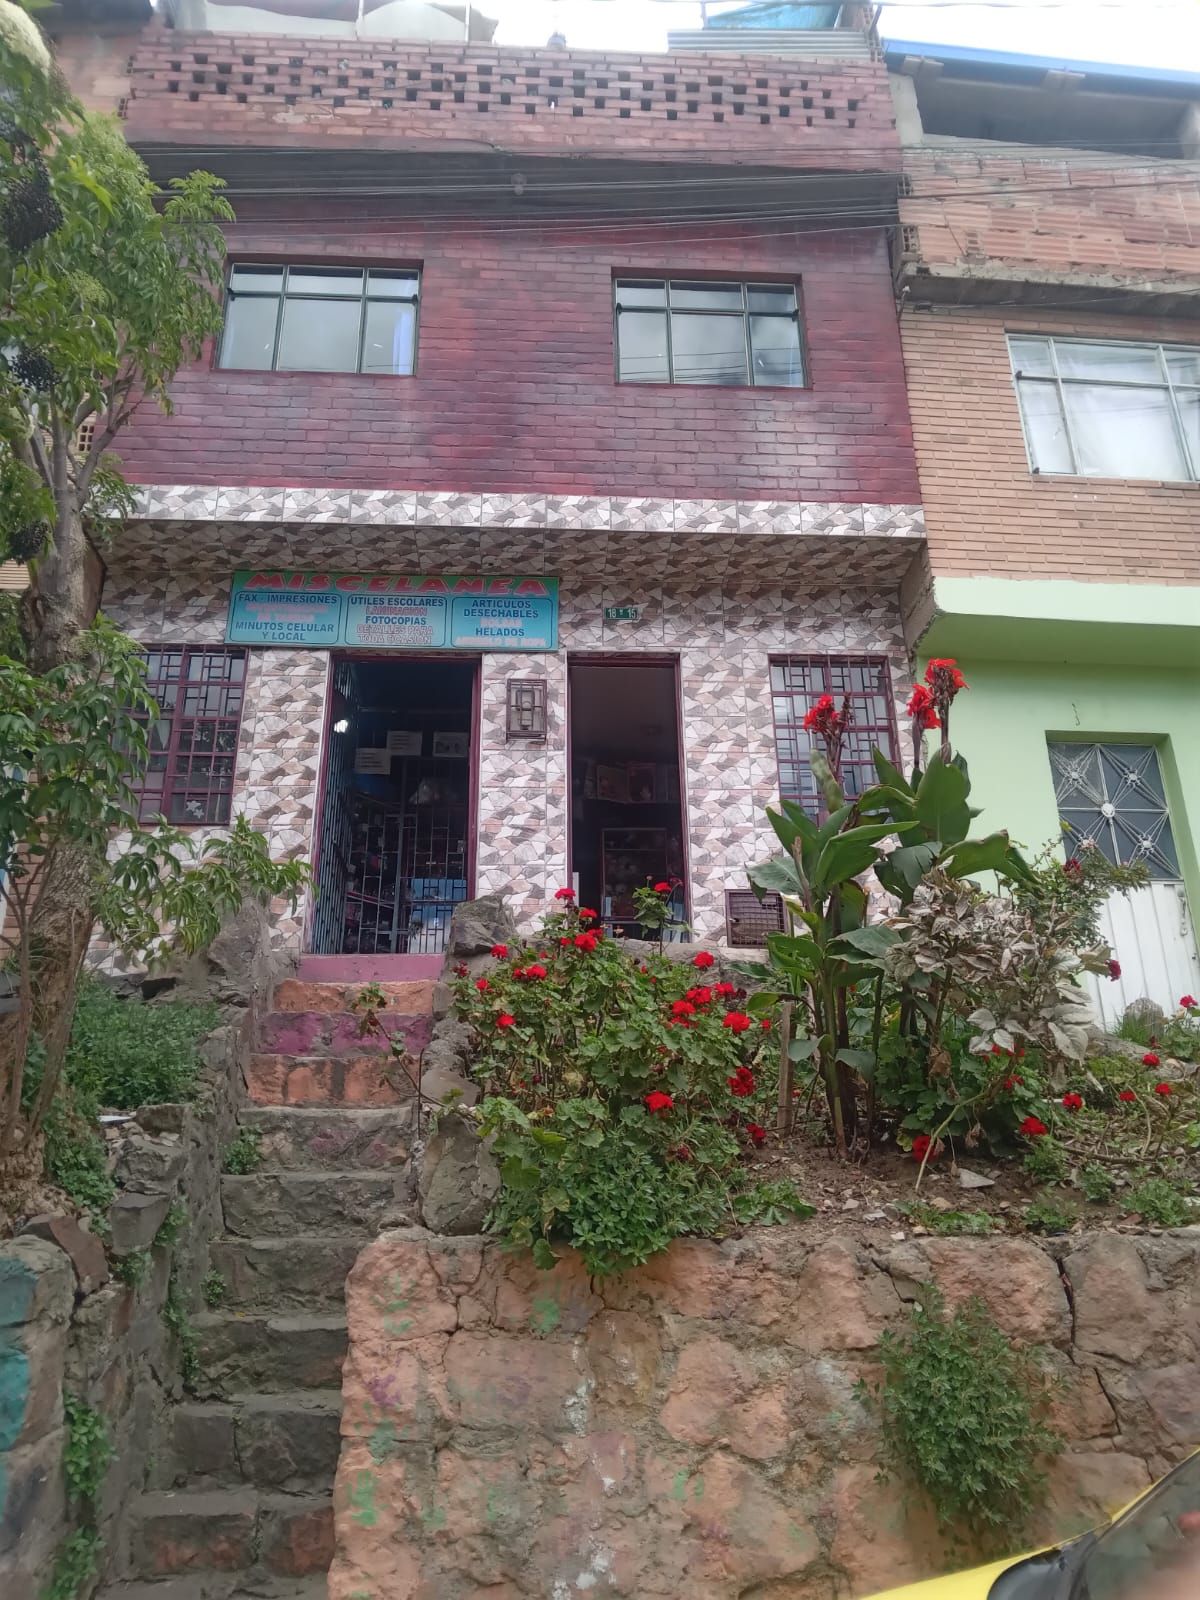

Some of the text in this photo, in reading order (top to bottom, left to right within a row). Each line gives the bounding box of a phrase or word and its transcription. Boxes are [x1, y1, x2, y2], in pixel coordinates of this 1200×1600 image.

[243, 574, 549, 595] MISCELANEA
[238, 593, 258, 602] FAX
[267, 594, 337, 604] IMPRESIONES
[350, 596, 444, 607] UTILES ESCOLARES
[472, 599, 531, 608] ARTICULOS
[463, 608, 539, 618] DESECHABLES
[365, 615, 426, 625] FOTOCOPIAS
[235, 621, 334, 632] MINUTOS CELULAR
[475, 627, 525, 636] HELADOS
[262, 631, 306, 641] Y LOCAL
